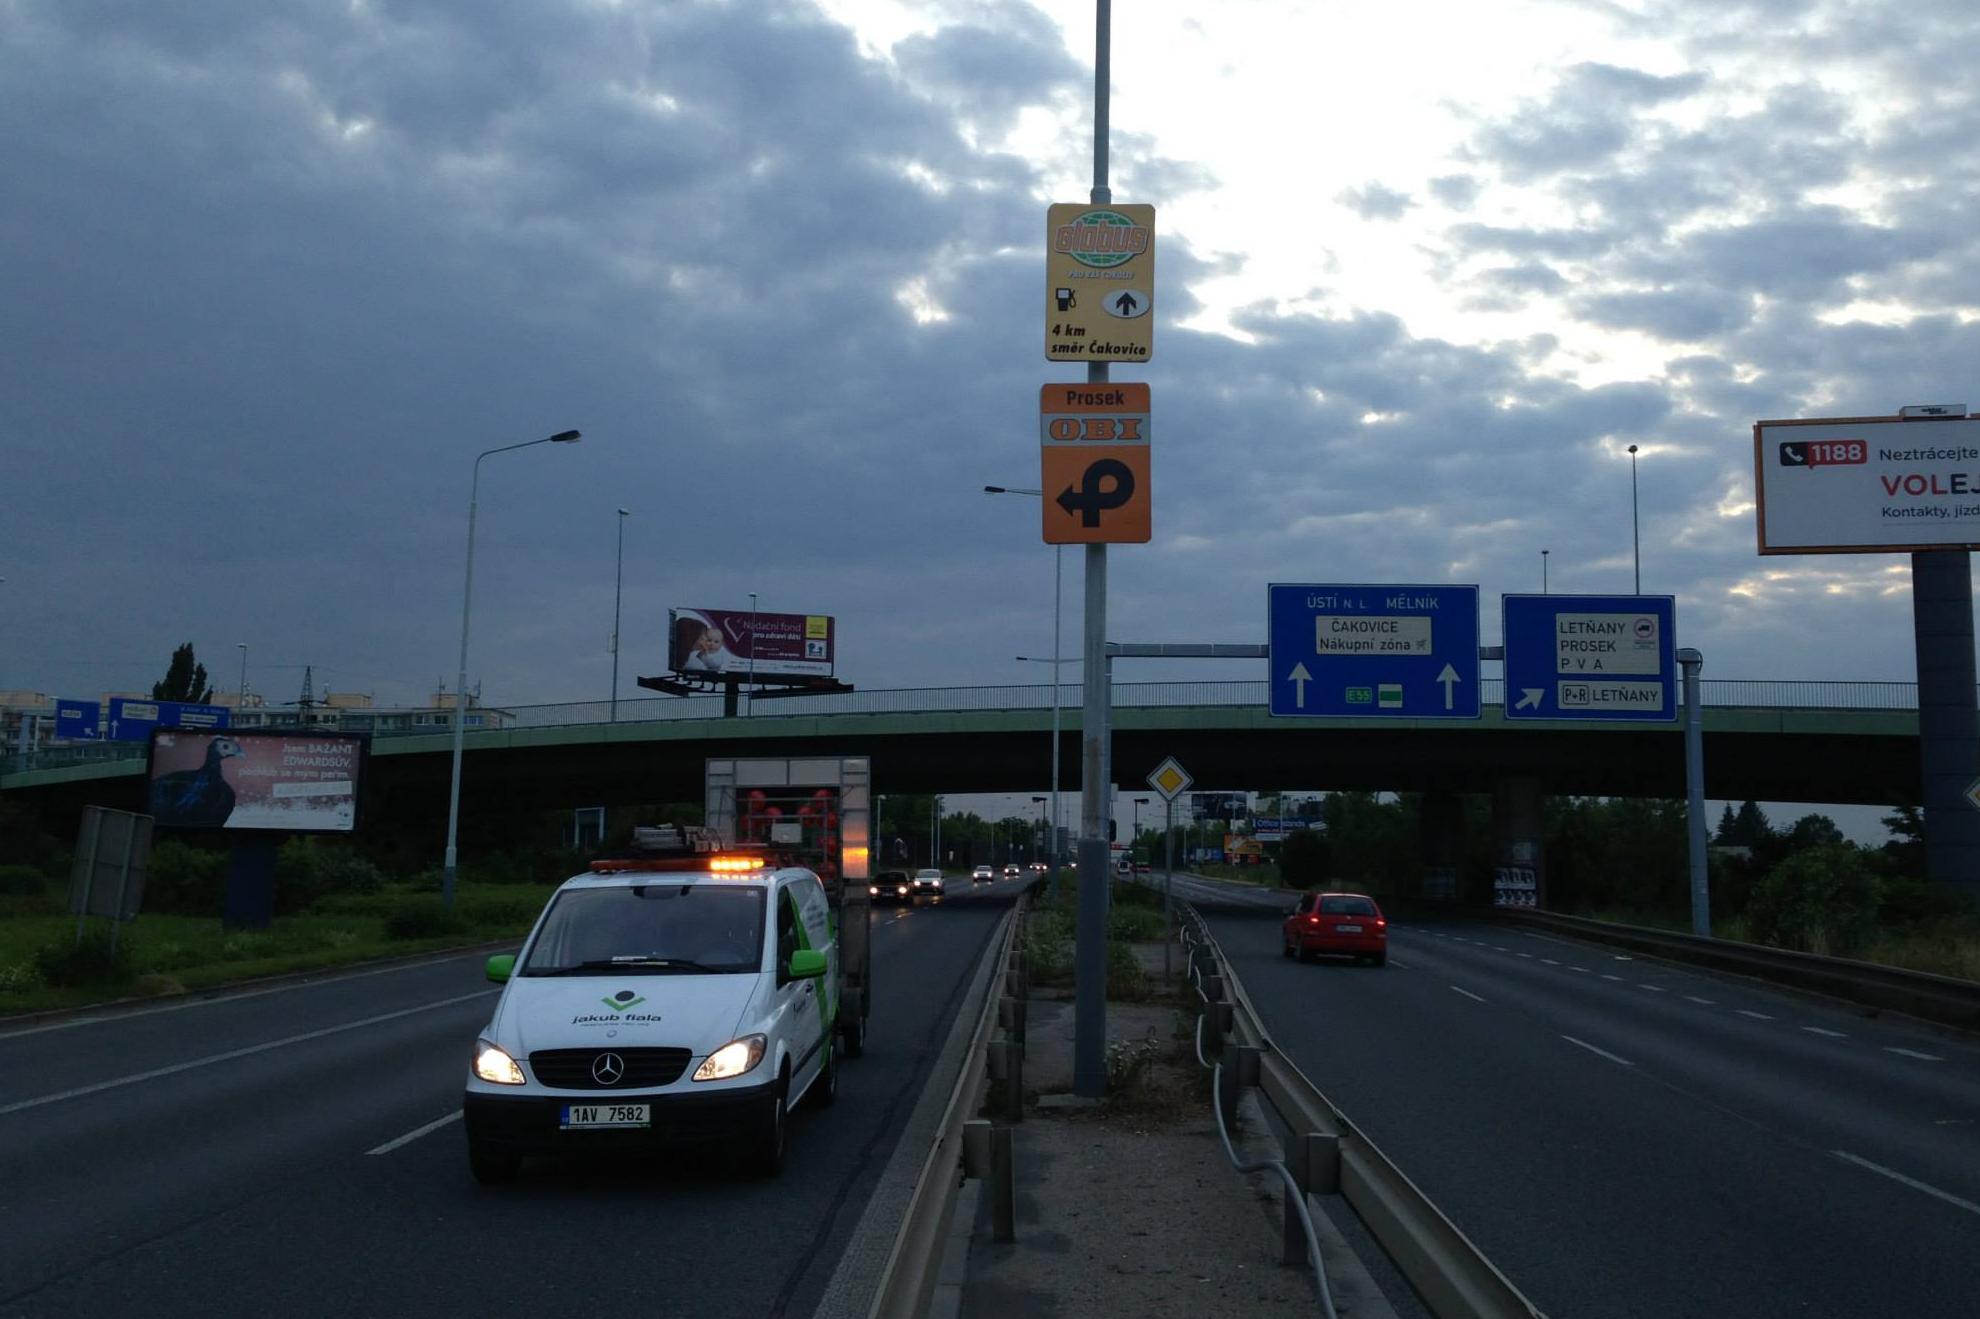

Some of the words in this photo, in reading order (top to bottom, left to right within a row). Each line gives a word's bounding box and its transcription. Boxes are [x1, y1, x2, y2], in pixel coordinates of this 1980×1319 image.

[1052, 324, 1061, 336] 4
[1065, 324, 1085, 336] km
[1051, 342, 1085, 353] směr
[1089, 339, 1147, 355] Čakovice
[1066, 389, 1124, 405] Prosek
[1050, 418, 1143, 441] OBI
[1812, 444, 1862, 461] 1188
[1880, 447, 1979, 461] Neztrácejte
[1882, 505, 1950, 519] Kontakty,
[1307, 591, 1339, 609] ÚSTÍ
[1343, 599, 1352, 609] N
[1359, 599, 1368, 609] L
[1386, 592, 1440, 610] MĚLNÍK
[782, 621, 802, 633] fond
[1331, 617, 1399, 633] ČAKOVICE
[1560, 619, 1626, 634] LETŇANY
[1320, 637, 1375, 653] Nákupní
[1379, 637, 1411, 651] zóna
[1560, 640, 1617, 652] PROSEK
[1562, 657, 1570, 670] P
[1577, 657, 1586, 670] V
[1593, 658, 1603, 670] A
[1565, 687, 1586, 702] P+R
[1592, 686, 1659, 702] LETŇANY
[570, 1014, 620, 1024] jakub
[624, 1014, 662, 1022] fiala
[573, 1107, 598, 1123] 1AV
[608, 1106, 644, 1122] 7582
